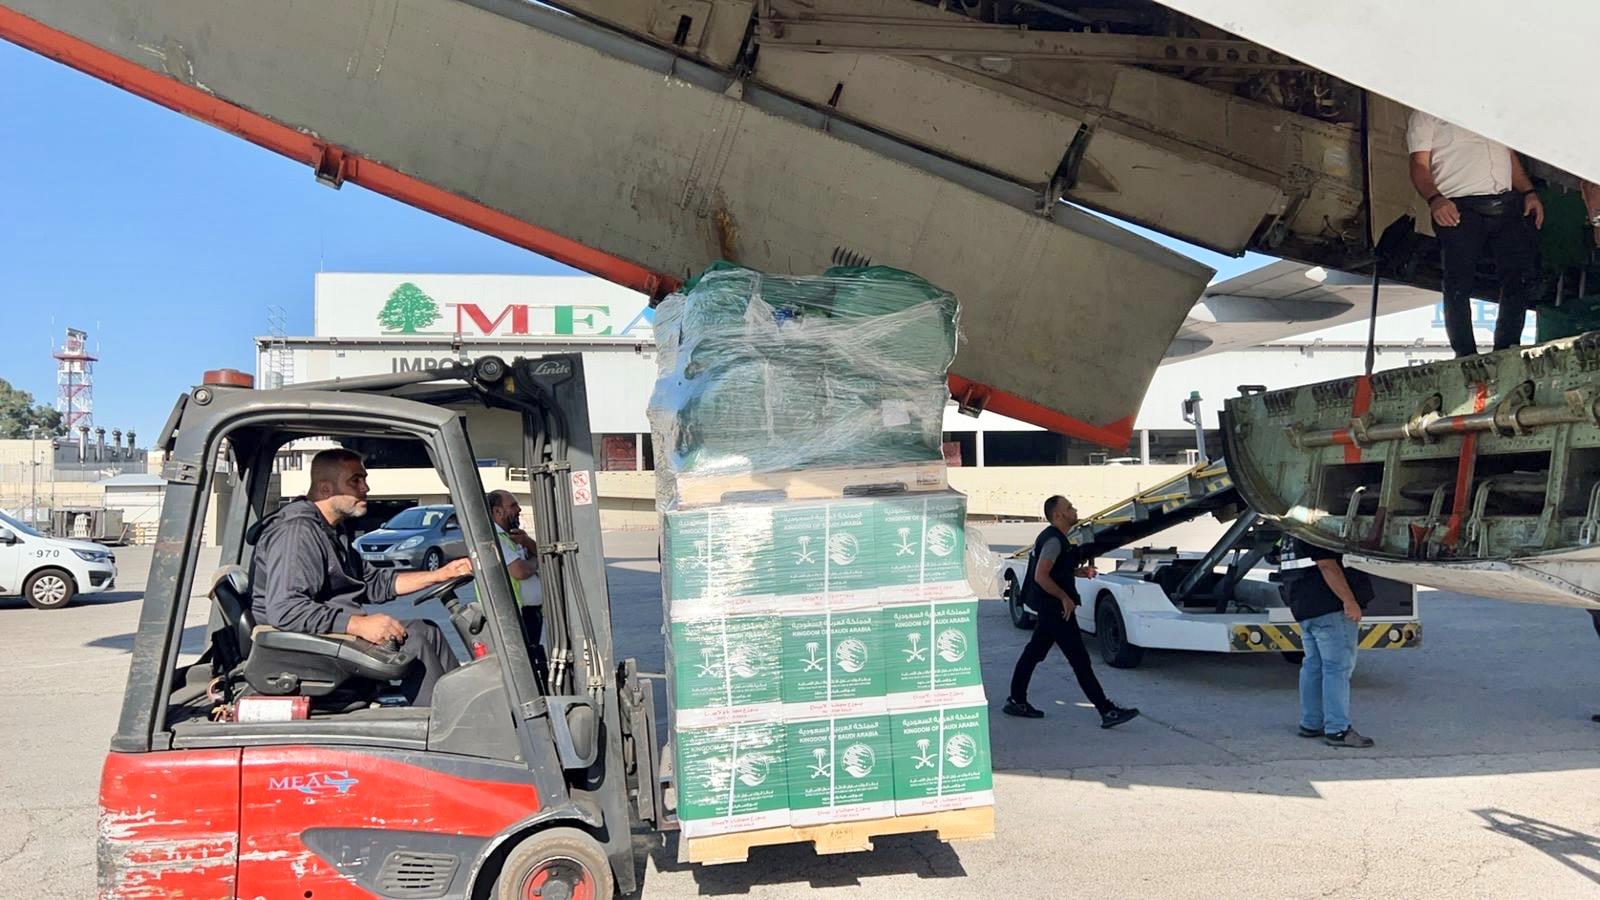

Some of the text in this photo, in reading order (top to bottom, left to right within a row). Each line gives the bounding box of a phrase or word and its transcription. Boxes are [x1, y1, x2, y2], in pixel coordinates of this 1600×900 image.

[392, 357, 480, 374] IMPO
[530, 360, 571, 376] Linde
[36, 549, 60, 558] 970
[894, 612, 923, 620] السعودية
[792, 629, 820, 637] KINGDOM
[849, 625, 872, 633] ARABIA
[902, 717, 932, 726] السعودية
[798, 727, 829, 736] السعودية
[903, 726, 930, 734] KINGDOM
[268, 775, 321, 791] MEA
